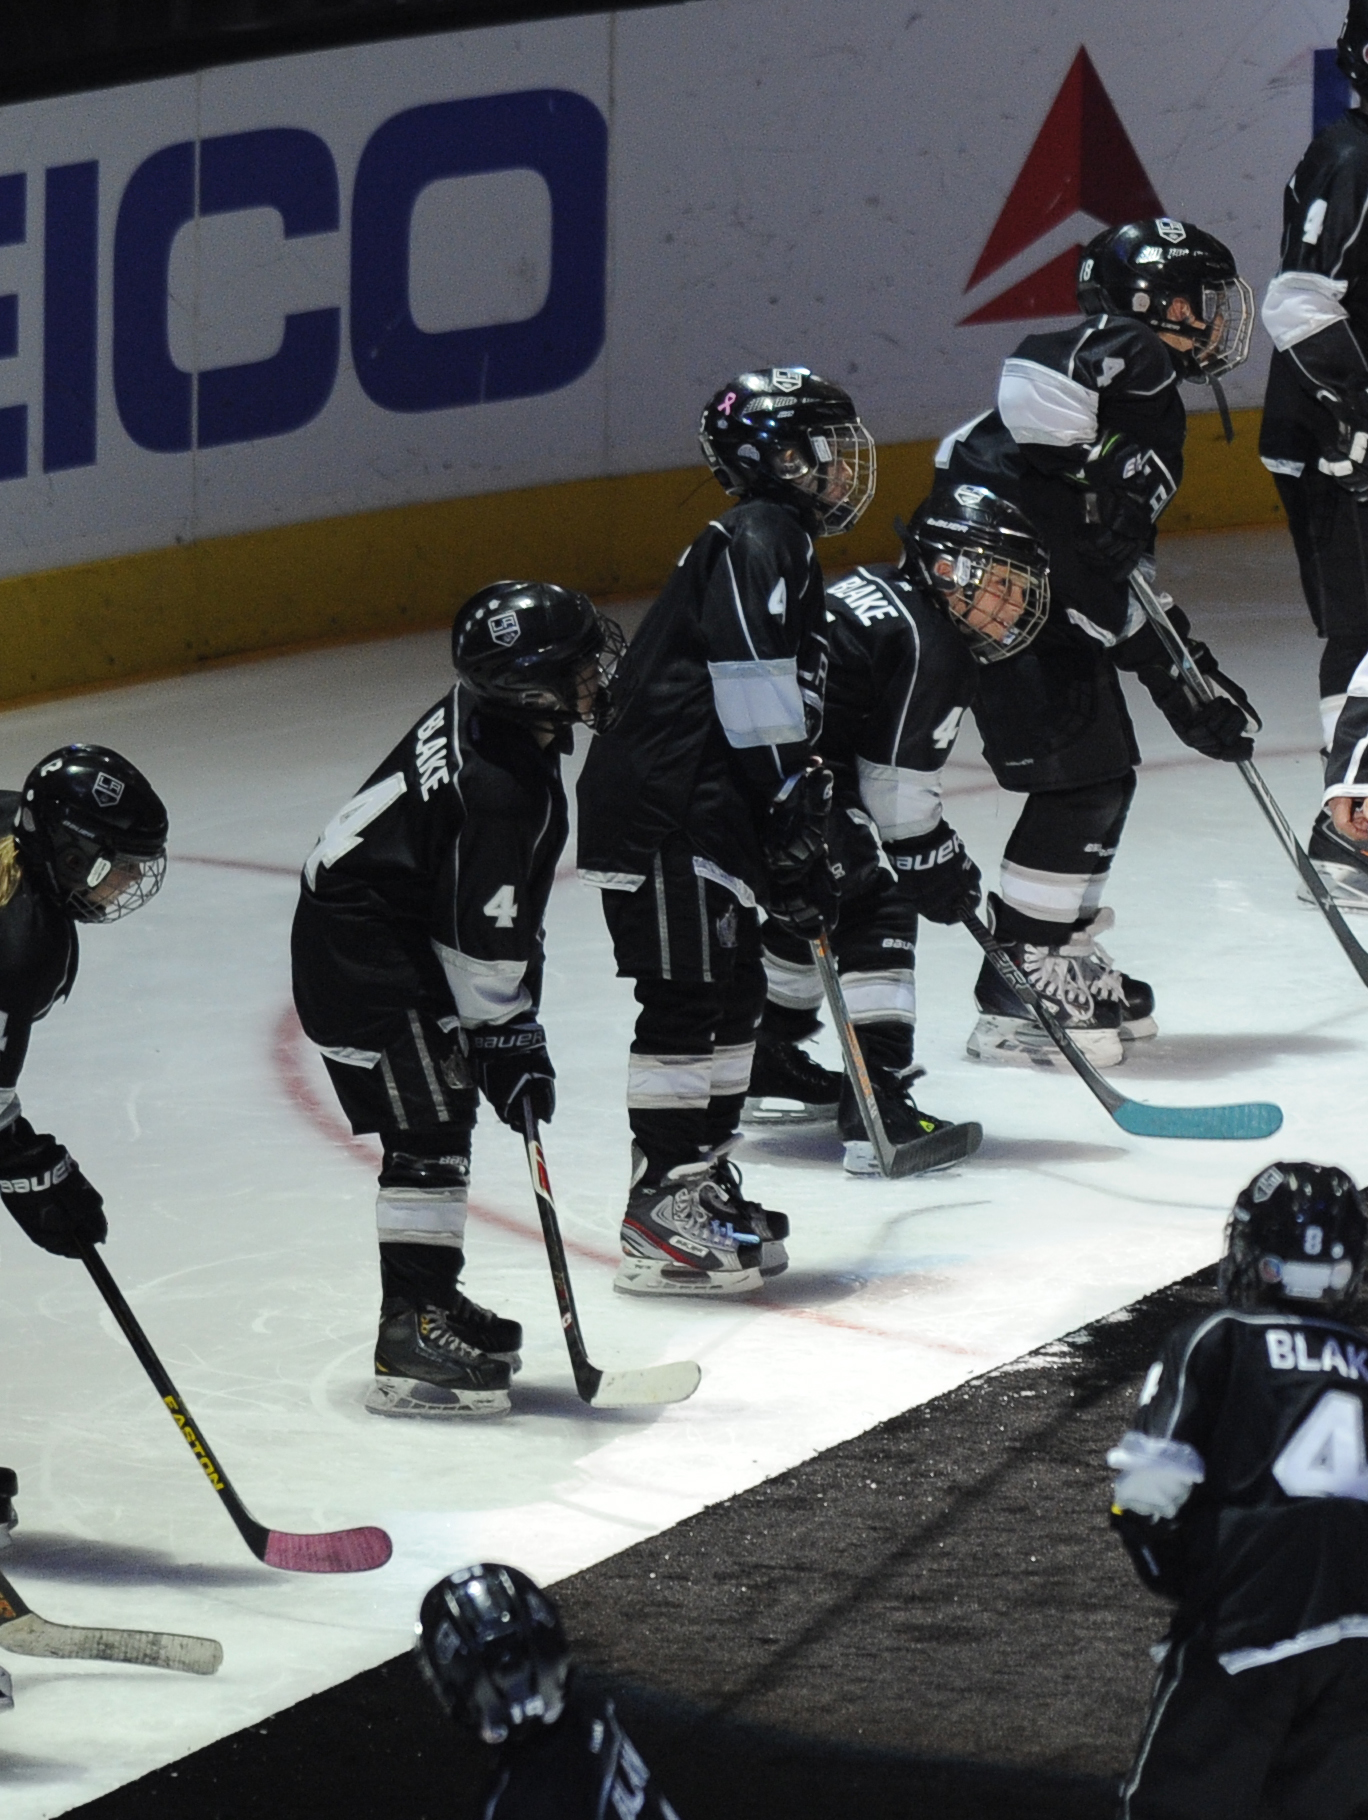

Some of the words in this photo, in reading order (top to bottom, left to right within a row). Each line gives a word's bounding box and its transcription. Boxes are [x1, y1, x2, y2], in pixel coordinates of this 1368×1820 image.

[0, 88, 608, 481] ICO
[1079, 258, 1094, 282] 18
[1097, 357, 1126, 387] 4
[826, 575, 899, 627] BLAKE
[933, 706, 963, 749] 4
[415, 707, 450, 802] BLAKE
[304, 771, 408, 892] 4
[482, 884, 519, 928] 4
[163, 1395, 225, 1491] EASTON
